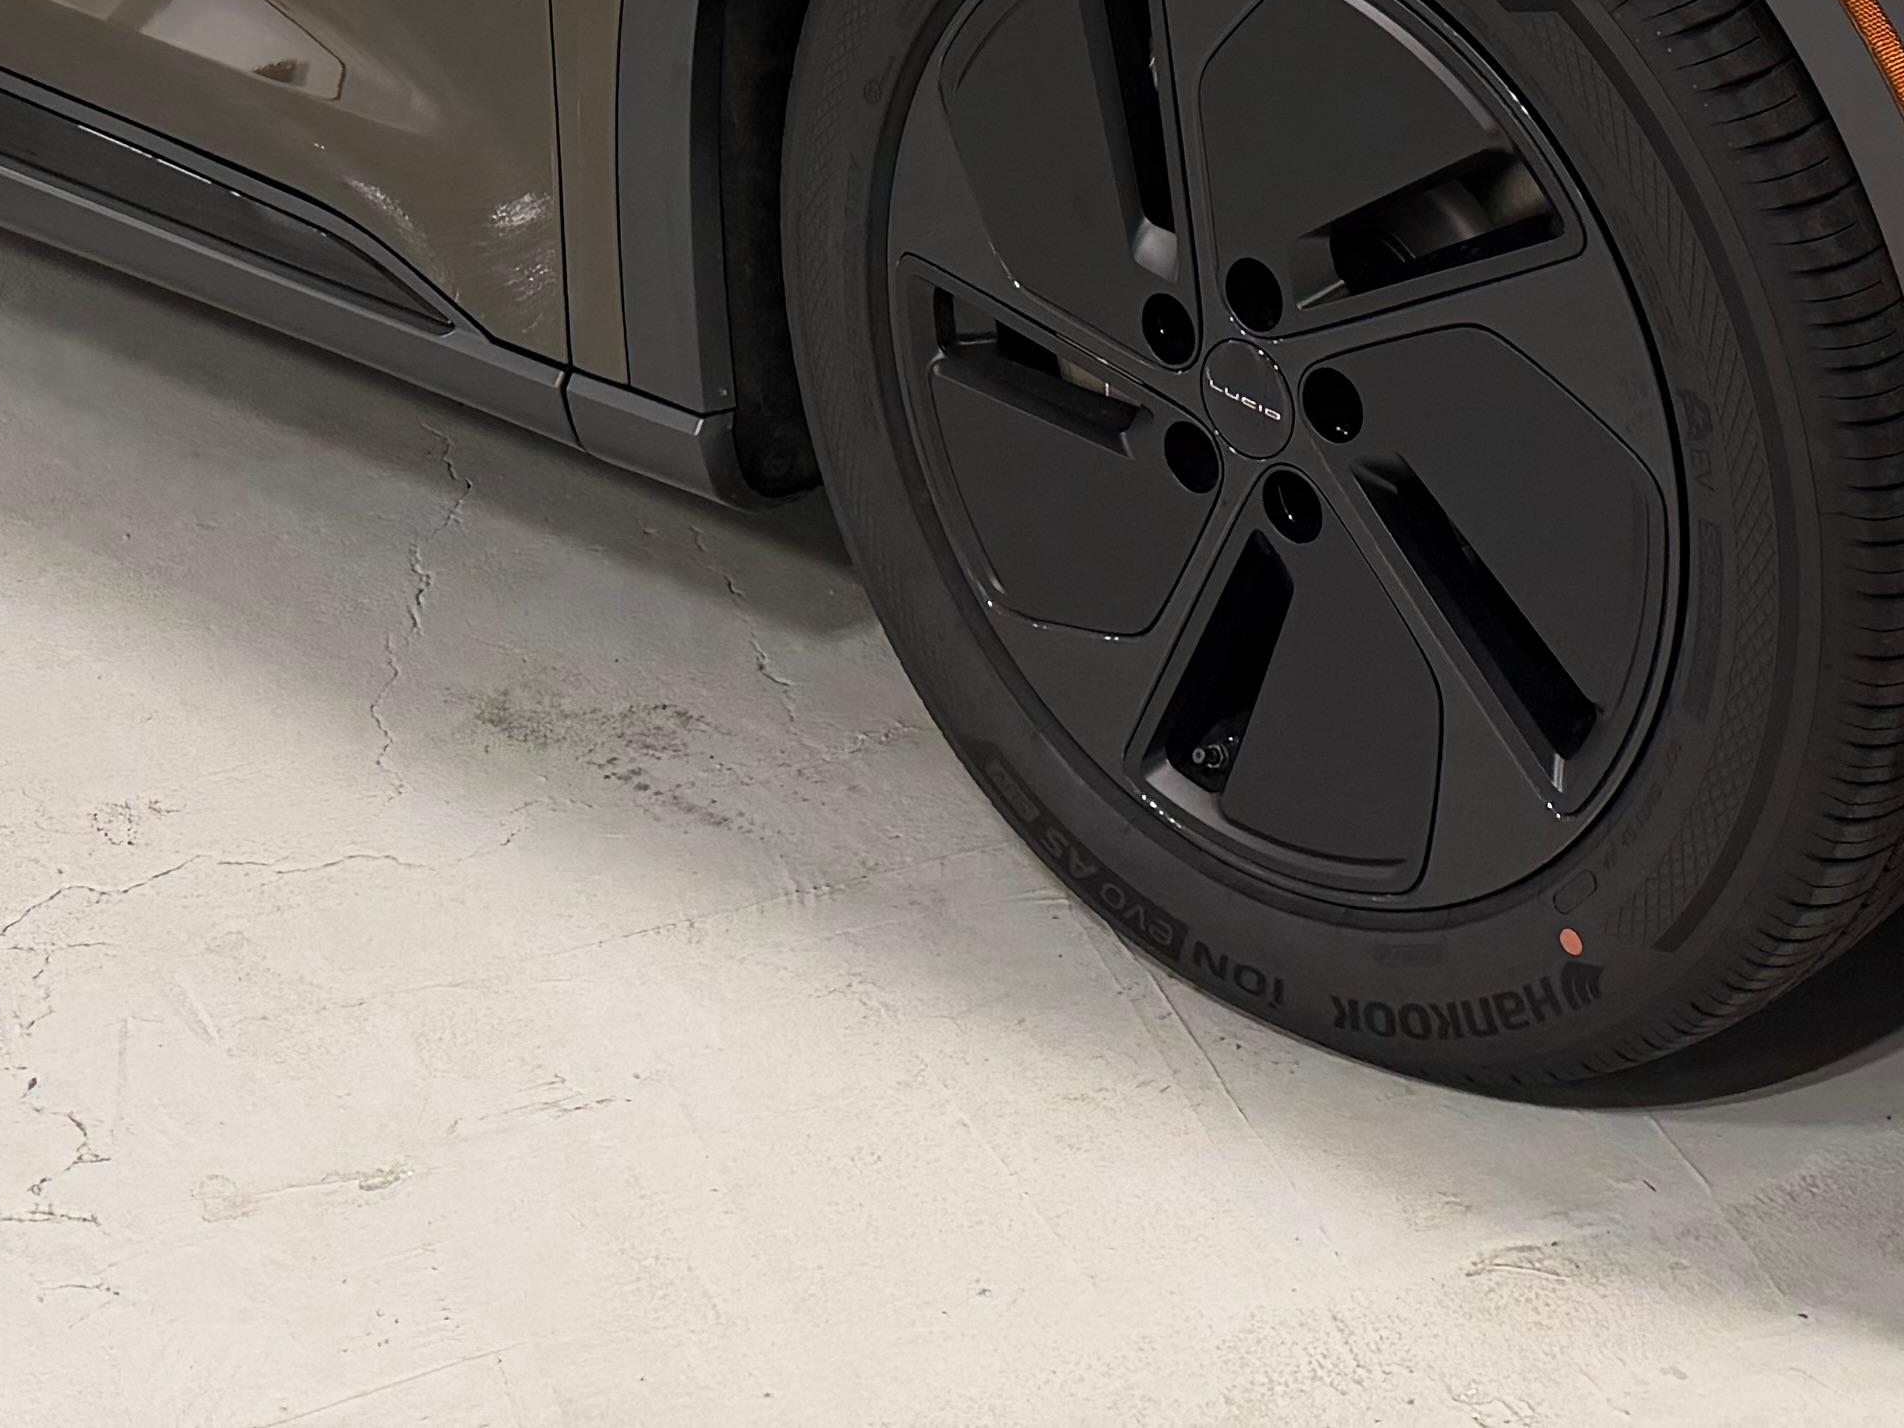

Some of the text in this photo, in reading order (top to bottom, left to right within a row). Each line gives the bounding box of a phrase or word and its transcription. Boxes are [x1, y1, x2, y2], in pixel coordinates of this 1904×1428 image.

[1208, 378, 1282, 422] LUCID
[1040, 827, 1099, 879] AS
[1101, 883, 1174, 945] evo
